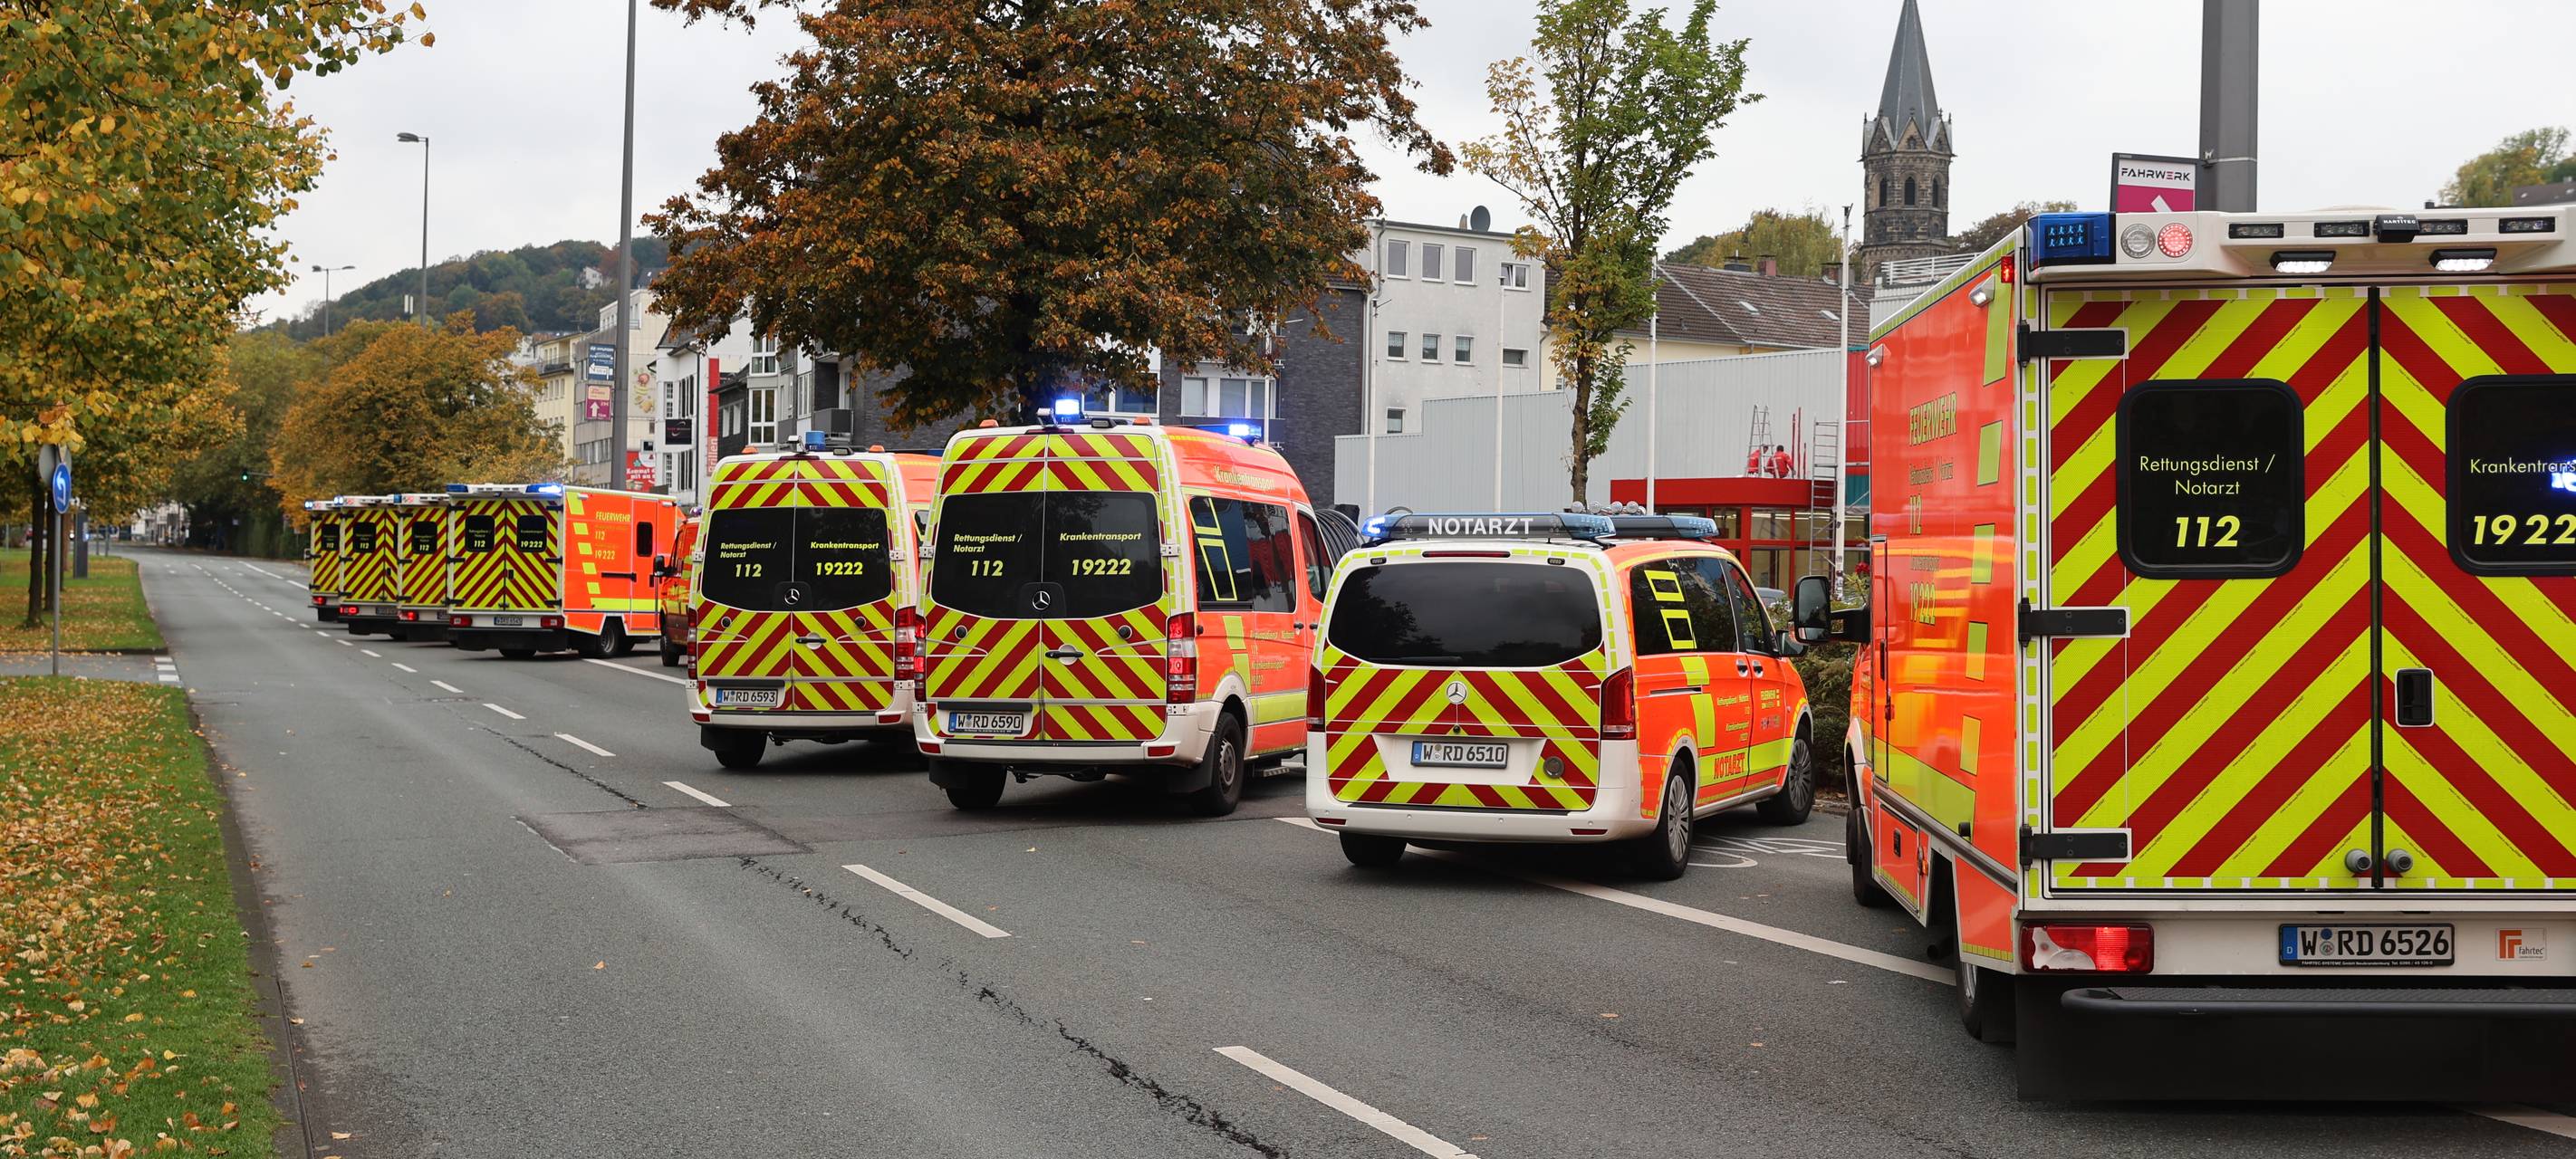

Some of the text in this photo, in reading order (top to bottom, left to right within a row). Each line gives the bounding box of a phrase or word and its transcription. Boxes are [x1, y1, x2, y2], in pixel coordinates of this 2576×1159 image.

[2121, 168, 2190, 181] FAHRWERK
[1909, 391, 1956, 445] FEUERWEHR
[2140, 454, 2275, 475] Rettungsdienst /
[2176, 479, 2240, 494] Notarzt
[595, 512, 631, 522] FEUERWEHR
[1909, 494, 1922, 535] 112
[1428, 518, 1533, 535] NOTARZT
[2176, 515, 2241, 547] 112
[596, 531, 605, 540] 112
[954, 533, 1016, 543] Rettungsdienst
[1060, 532, 1141, 542] Krankentransport
[811, 541, 879, 551] Krankentransport
[735, 564, 762, 577] 112
[816, 562, 863, 576] 19222
[971, 560, 1004, 576] 112
[1072, 559, 1131, 576] 19222
[724, 691, 775, 702] W RD 6593
[958, 715, 1021, 728] W RD 6590
[1423, 745, 1433, 761] W
[1443, 746, 1463, 761] RD
[1466, 746, 1504, 761] 6510
[1714, 752, 1745, 780] NOTARZT
[2301, 931, 2317, 955] W
[2338, 930, 2373, 956] RD
[2380, 930, 2449, 956] 6526
